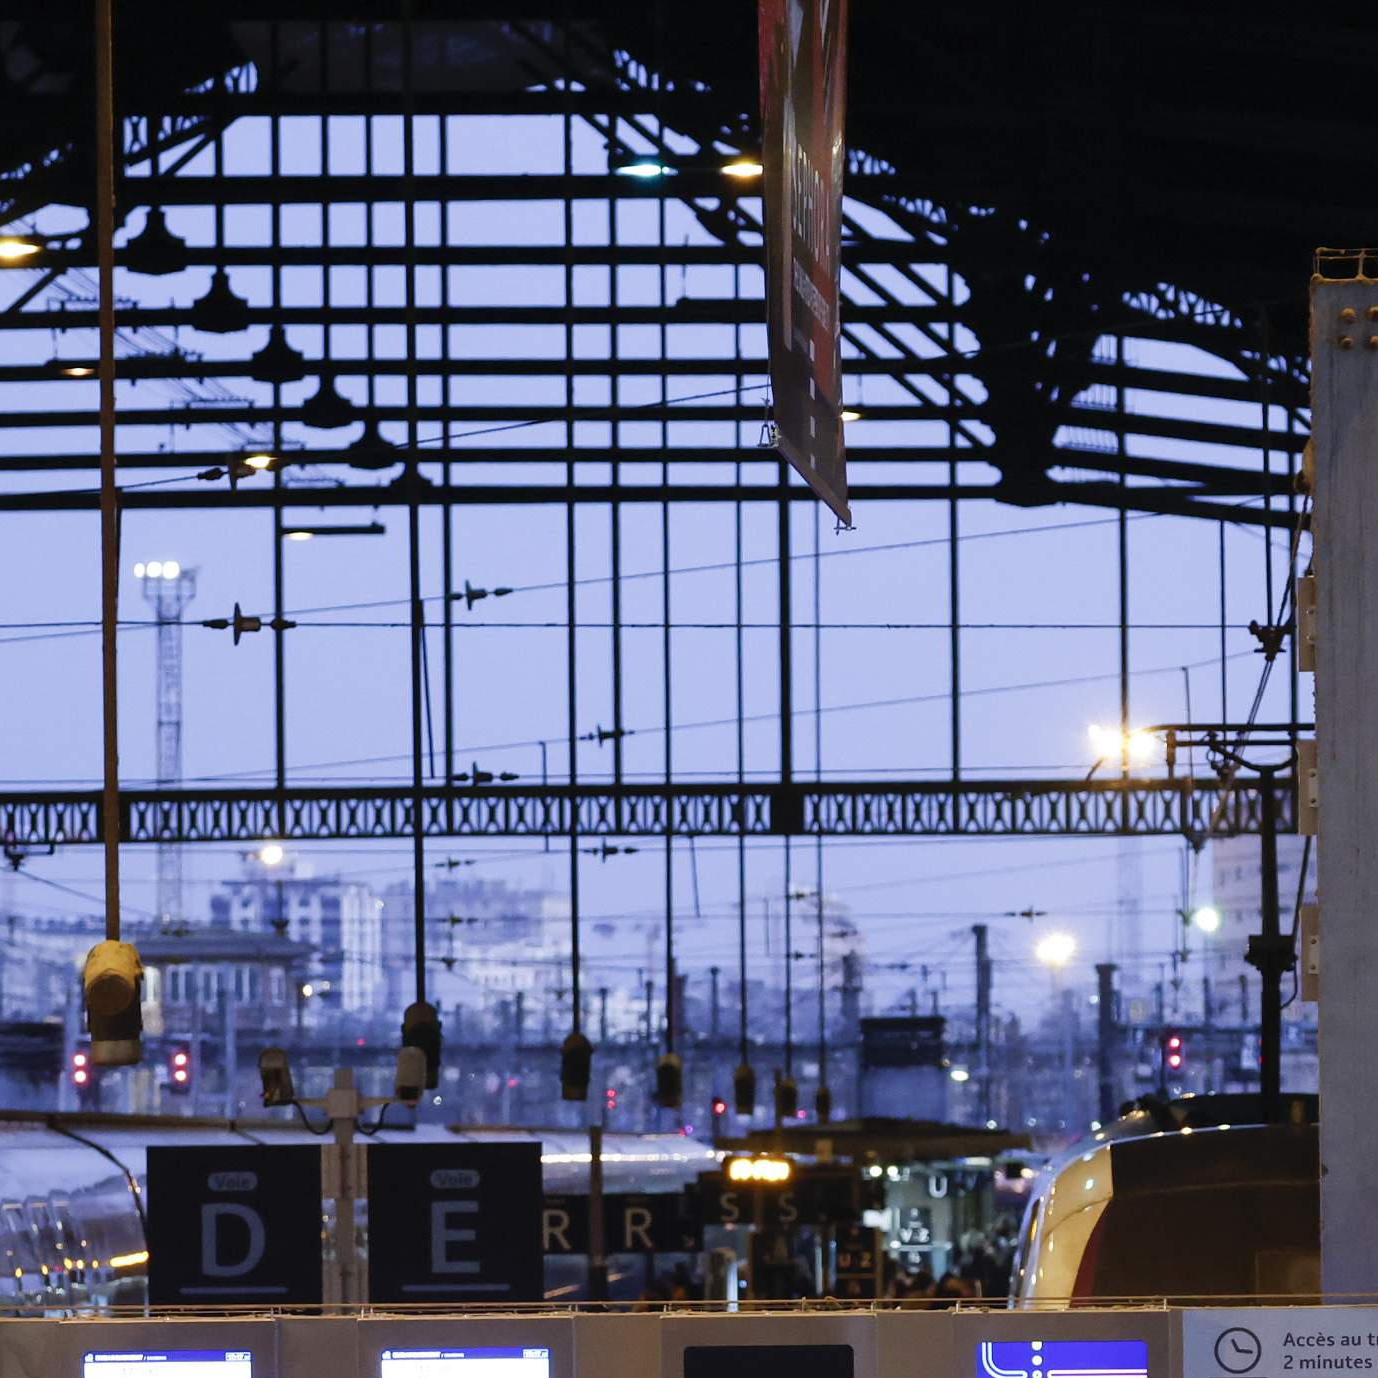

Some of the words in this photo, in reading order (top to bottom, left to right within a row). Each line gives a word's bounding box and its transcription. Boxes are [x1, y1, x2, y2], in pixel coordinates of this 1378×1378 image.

[791, 145, 831, 278] SEPHORA
[201, 1204, 265, 1276] D
[431, 1203, 481, 1273] E
[543, 1209, 571, 1250] R
[625, 1208, 654, 1248] R
[1283, 1332, 1334, 1347] Accès
[1341, 1335, 1361, 1346] au
[1283, 1355, 1293, 1370] 2
[1300, 1354, 1372, 1369] minutes
